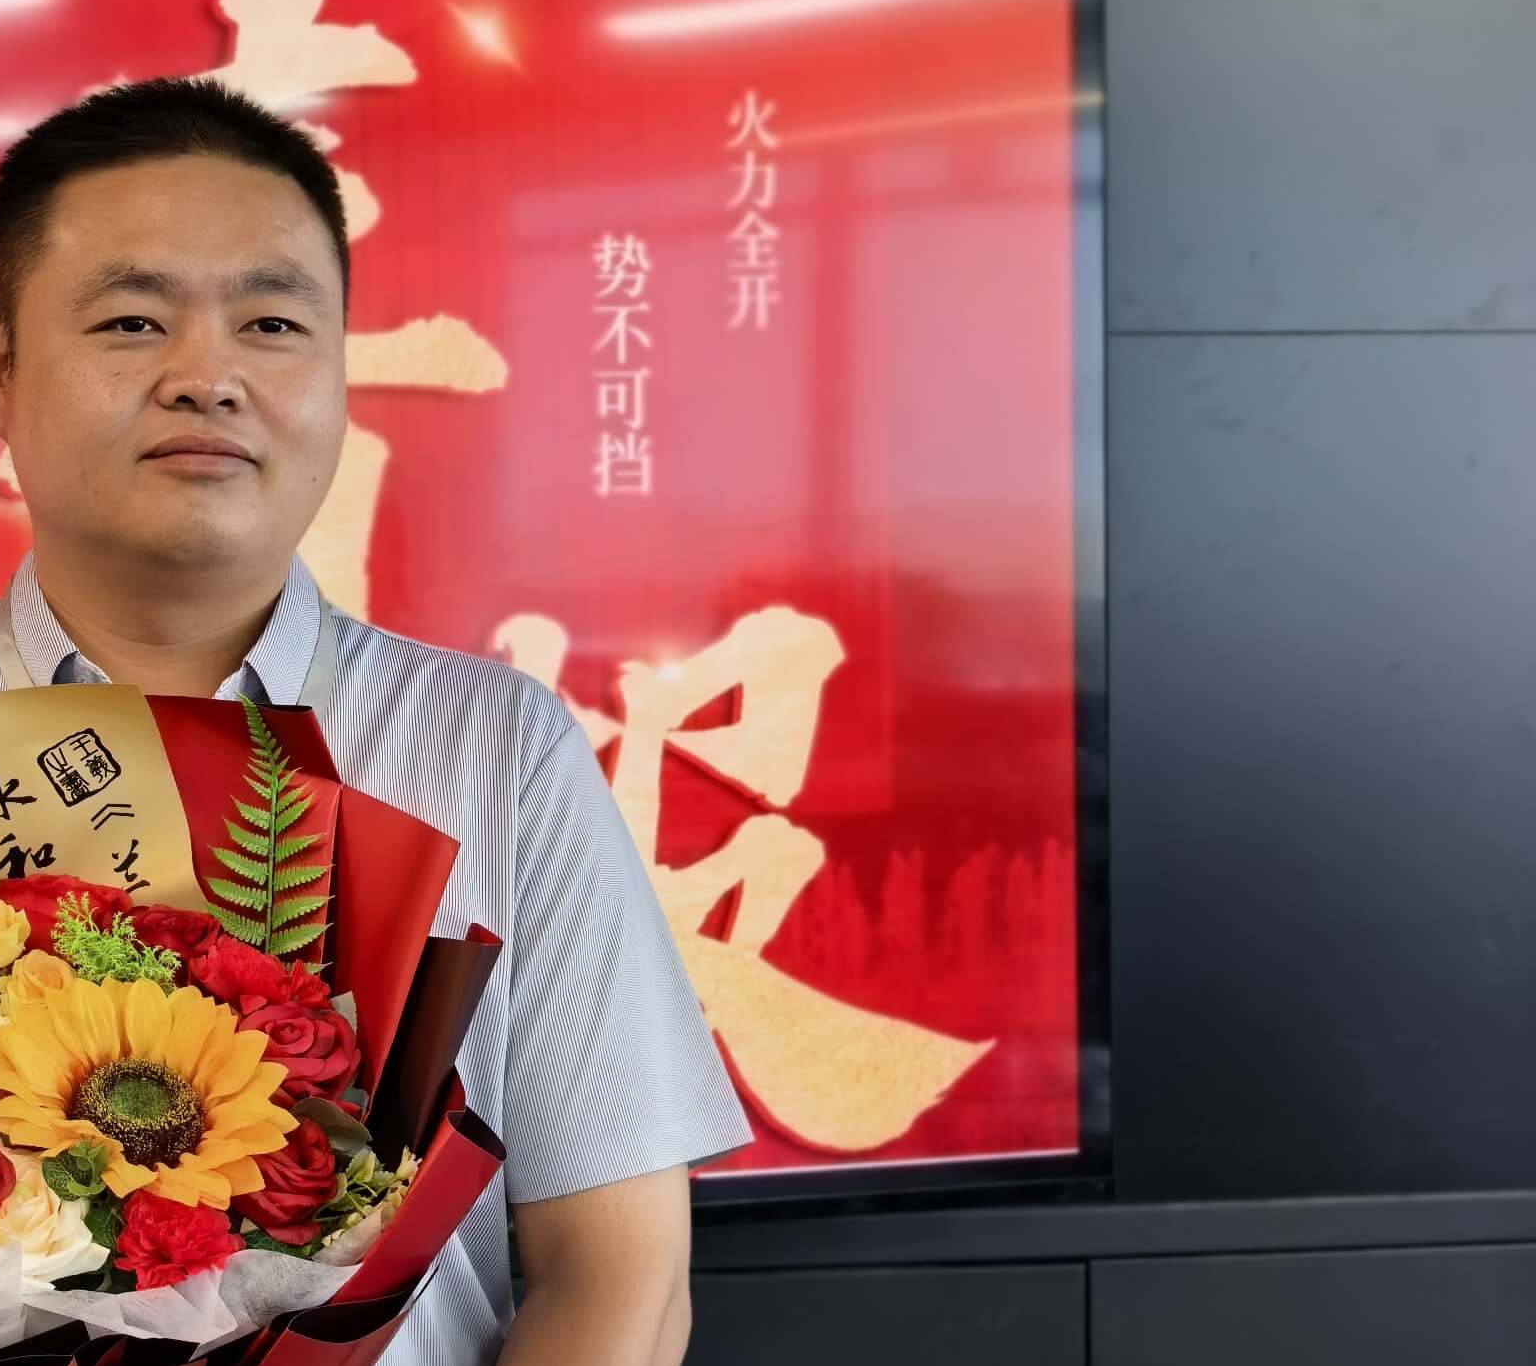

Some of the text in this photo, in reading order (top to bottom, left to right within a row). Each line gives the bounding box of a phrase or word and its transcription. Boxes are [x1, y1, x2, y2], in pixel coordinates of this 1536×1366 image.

[727, 89, 780, 329] 火力全开
[593, 232, 652, 497] 势不可挡
